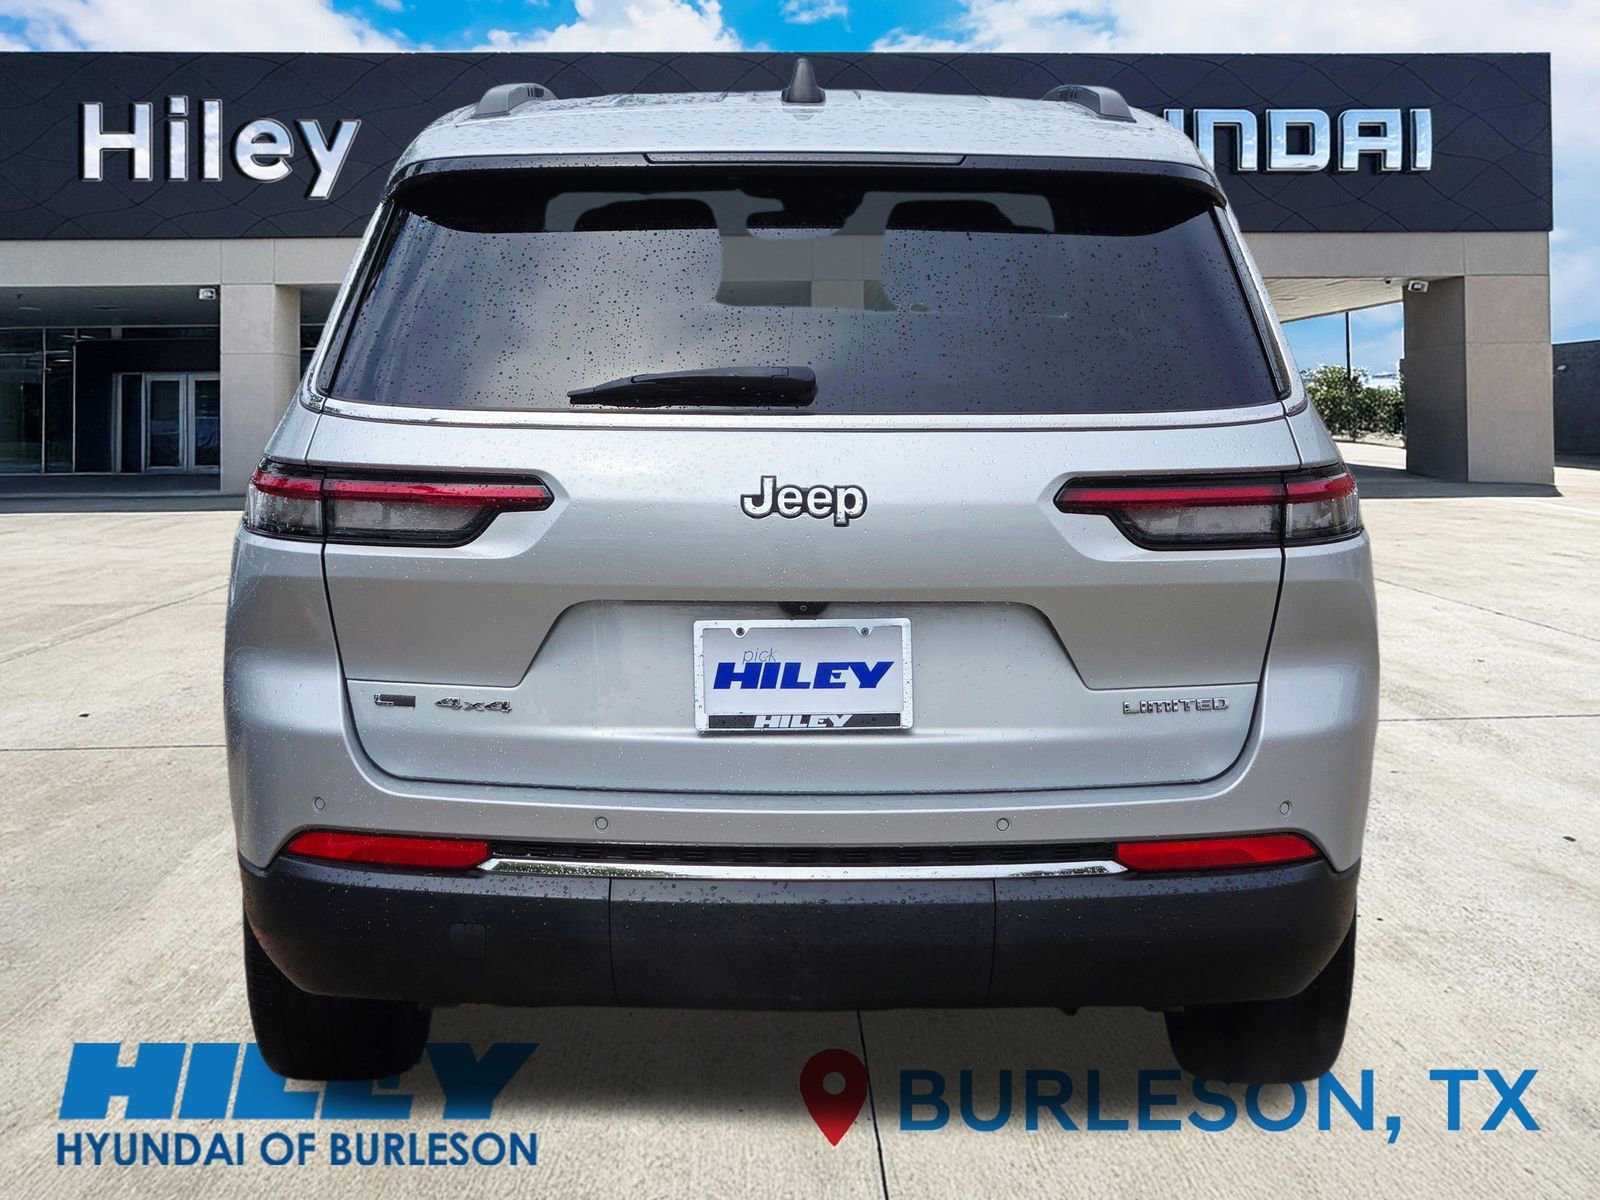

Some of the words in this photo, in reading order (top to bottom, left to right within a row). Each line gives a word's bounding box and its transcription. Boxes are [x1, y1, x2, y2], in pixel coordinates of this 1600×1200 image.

[80, 95, 361, 200] Hiley
[1163, 108, 1432, 171] NDAI
[740, 475, 868, 527] Jeep
[742, 648, 778, 664] pick
[713, 661, 895, 690] HILEY
[435, 696, 512, 713] 4x4
[1122, 697, 1229, 714] LIMITED
[754, 714, 853, 729] HILEY
